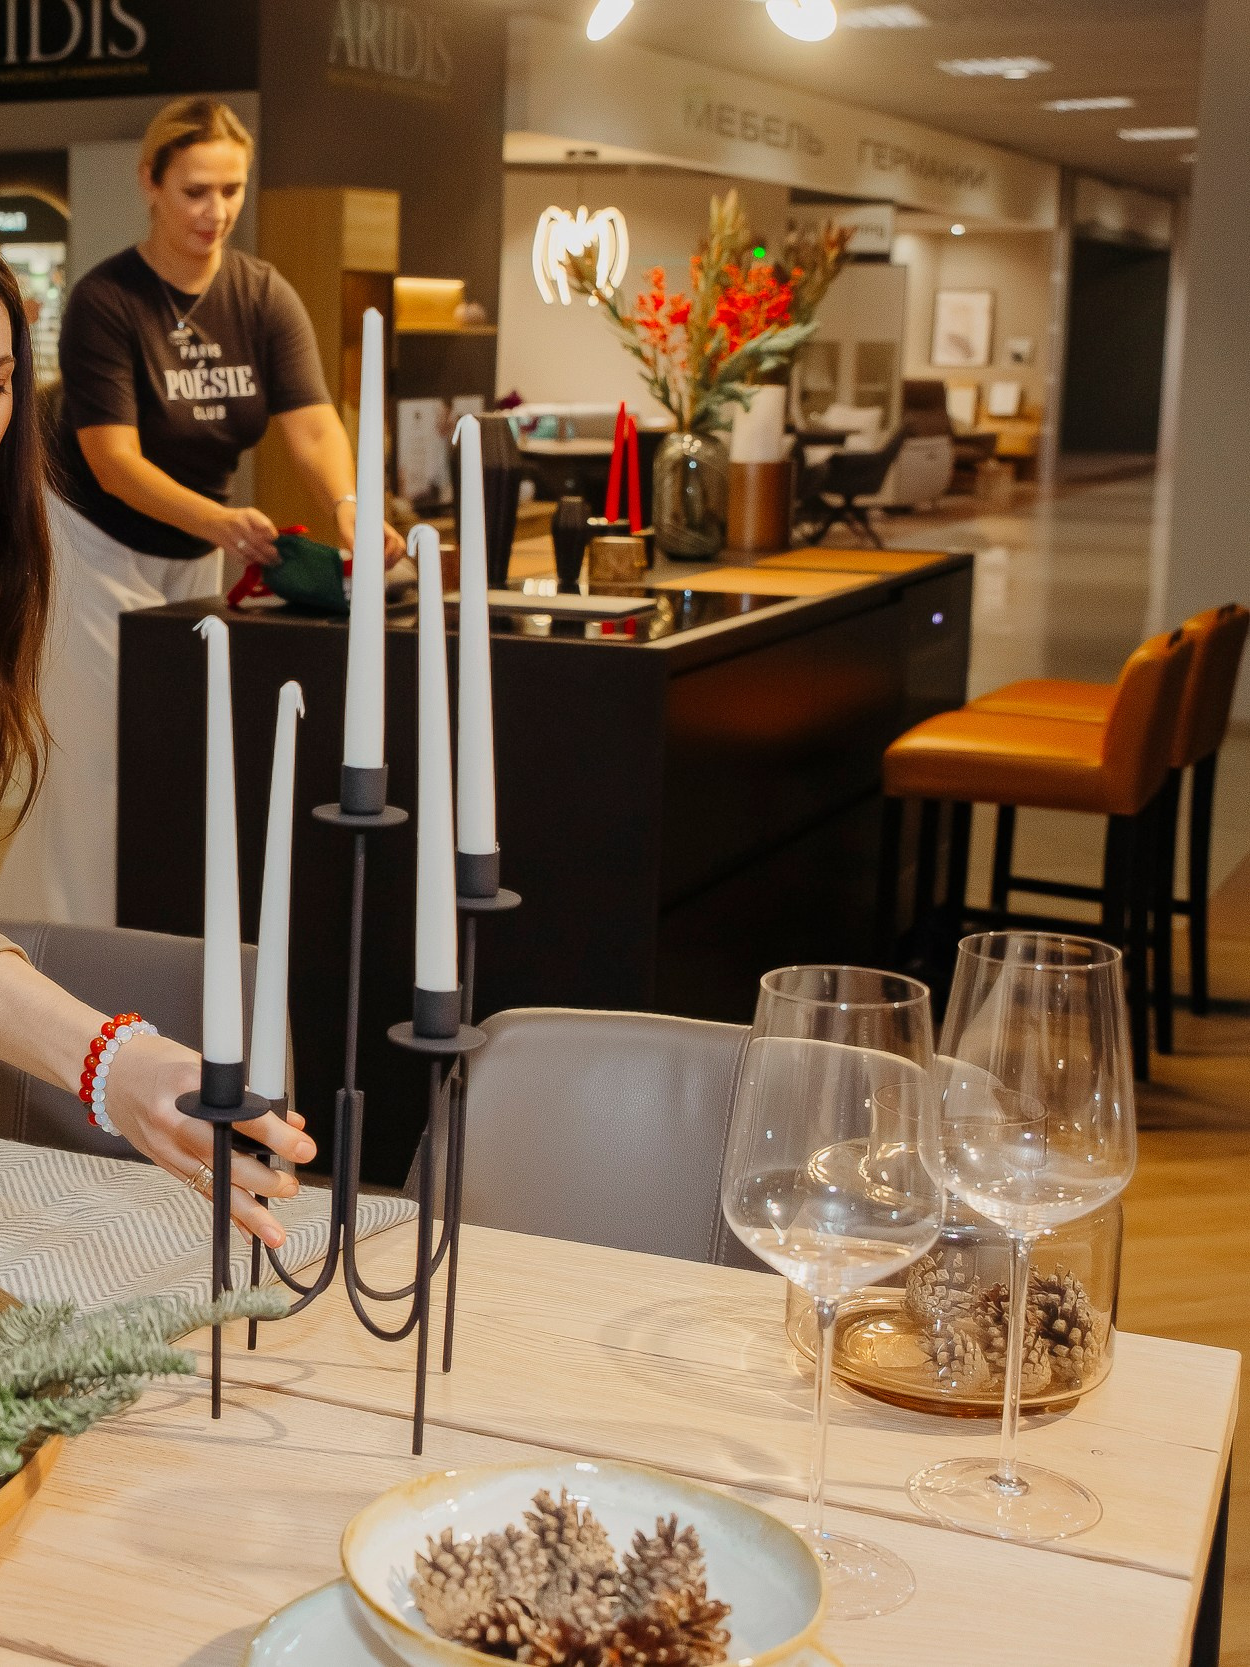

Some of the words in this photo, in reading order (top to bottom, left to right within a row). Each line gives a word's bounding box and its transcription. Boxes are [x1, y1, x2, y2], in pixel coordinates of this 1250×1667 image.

[328, 0, 452, 87] ARIDIS
[683, 93, 826, 157] МЕБЕЛЬ
[164, 359, 257, 401] POÉSIE
[192, 404, 227, 421] CLUB
